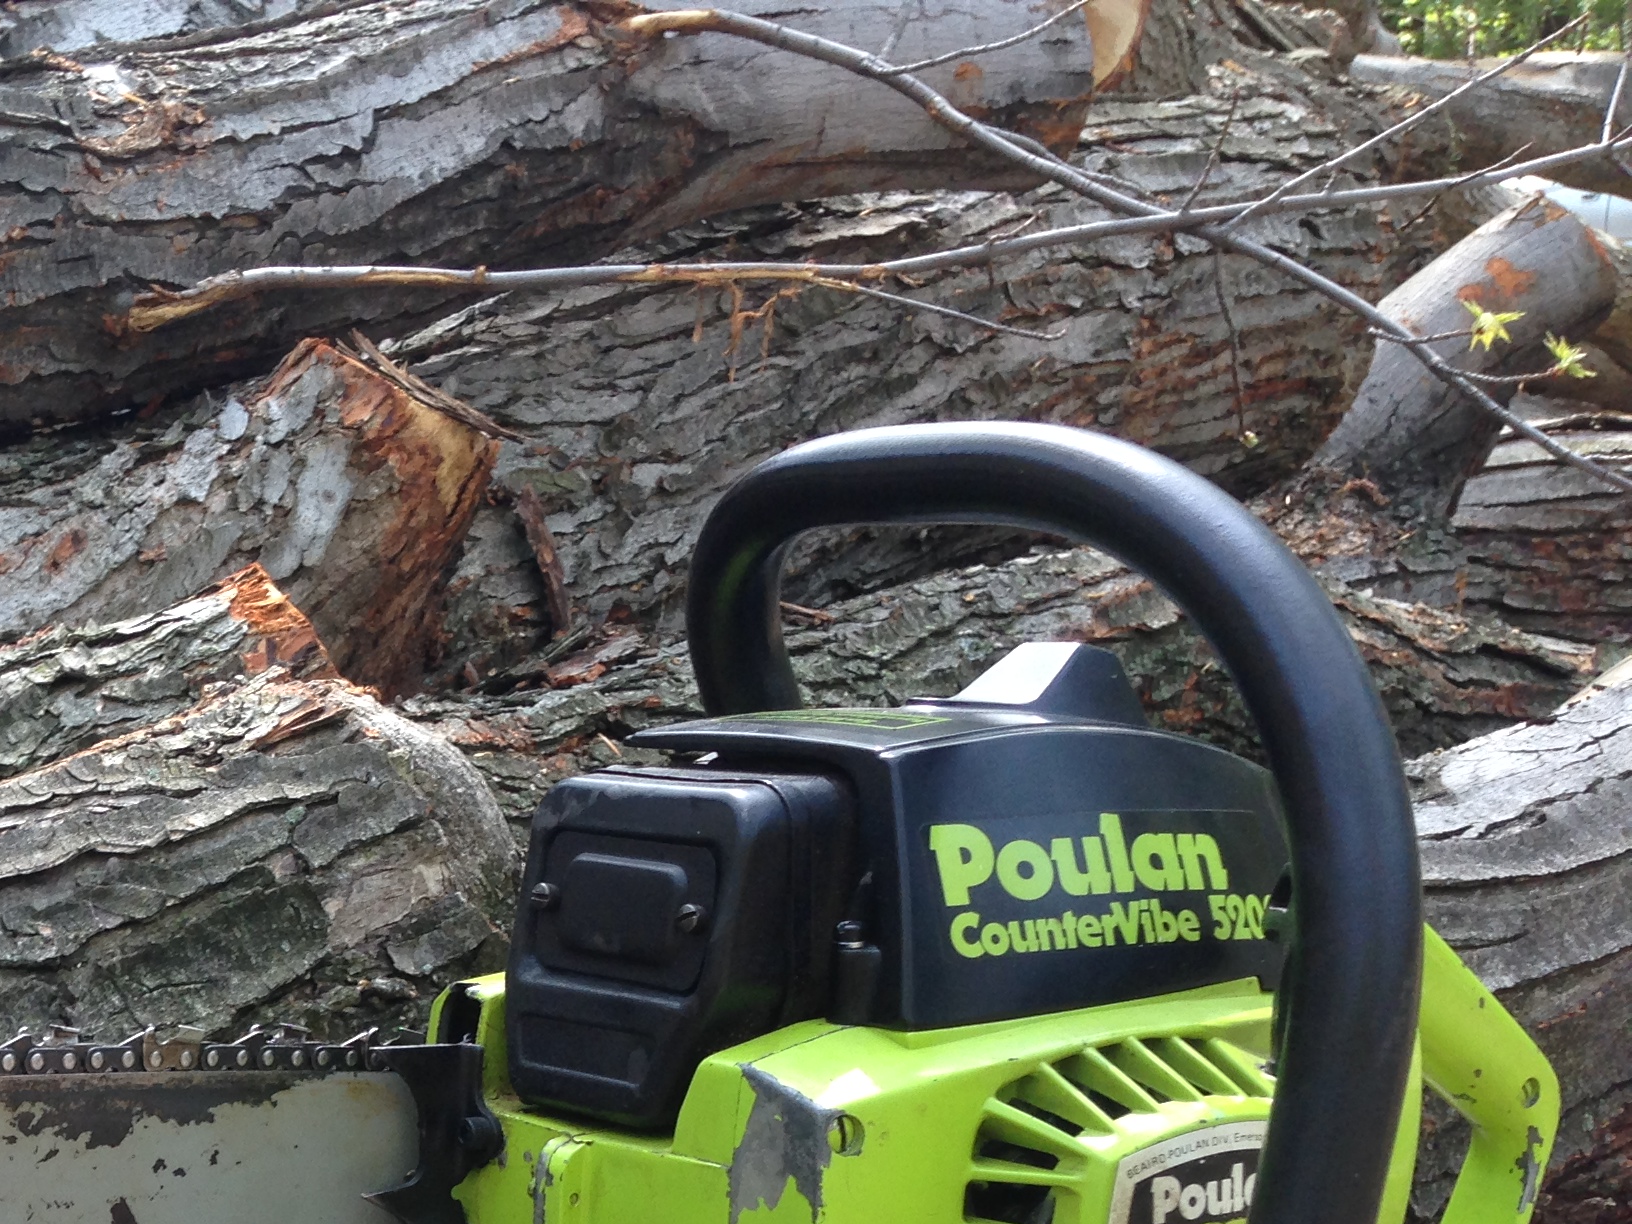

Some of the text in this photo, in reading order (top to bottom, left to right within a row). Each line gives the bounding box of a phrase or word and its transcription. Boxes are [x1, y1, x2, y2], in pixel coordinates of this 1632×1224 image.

[930, 813, 1228, 906] Poulan
[950, 894, 1272, 958] CounterVibe 520
